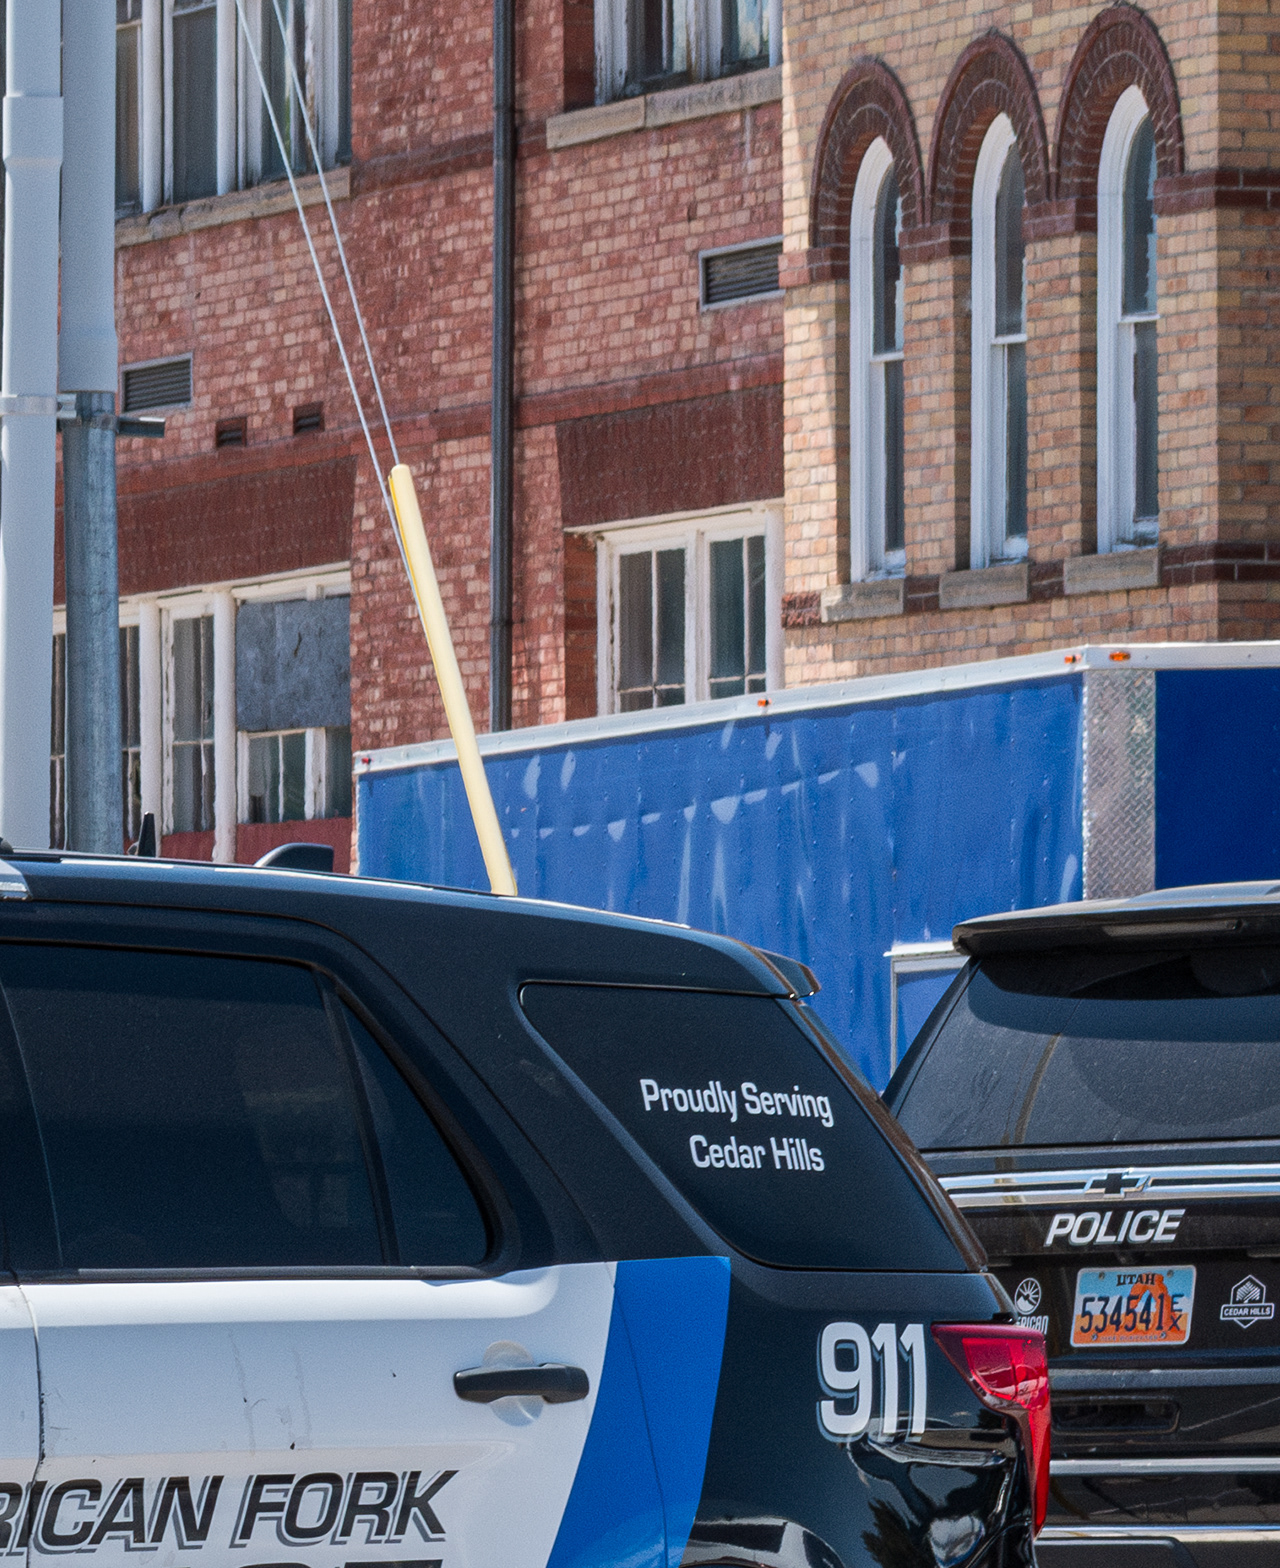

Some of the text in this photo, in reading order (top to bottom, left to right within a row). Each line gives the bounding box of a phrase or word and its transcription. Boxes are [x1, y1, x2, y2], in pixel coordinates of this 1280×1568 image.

[639, 1078, 835, 1128] Proudly Serving
[689, 1134, 826, 1172] Cedar Hills
[1043, 1208, 1186, 1248] POLICE
[1116, 1273, 1156, 1287] UTAH
[1080, 1293, 1165, 1334] 534541
[1223, 1306, 1271, 1316] CEDAR HILLS
[817, 1320, 928, 1443] 911
[230, 1469, 459, 1550] FORK
